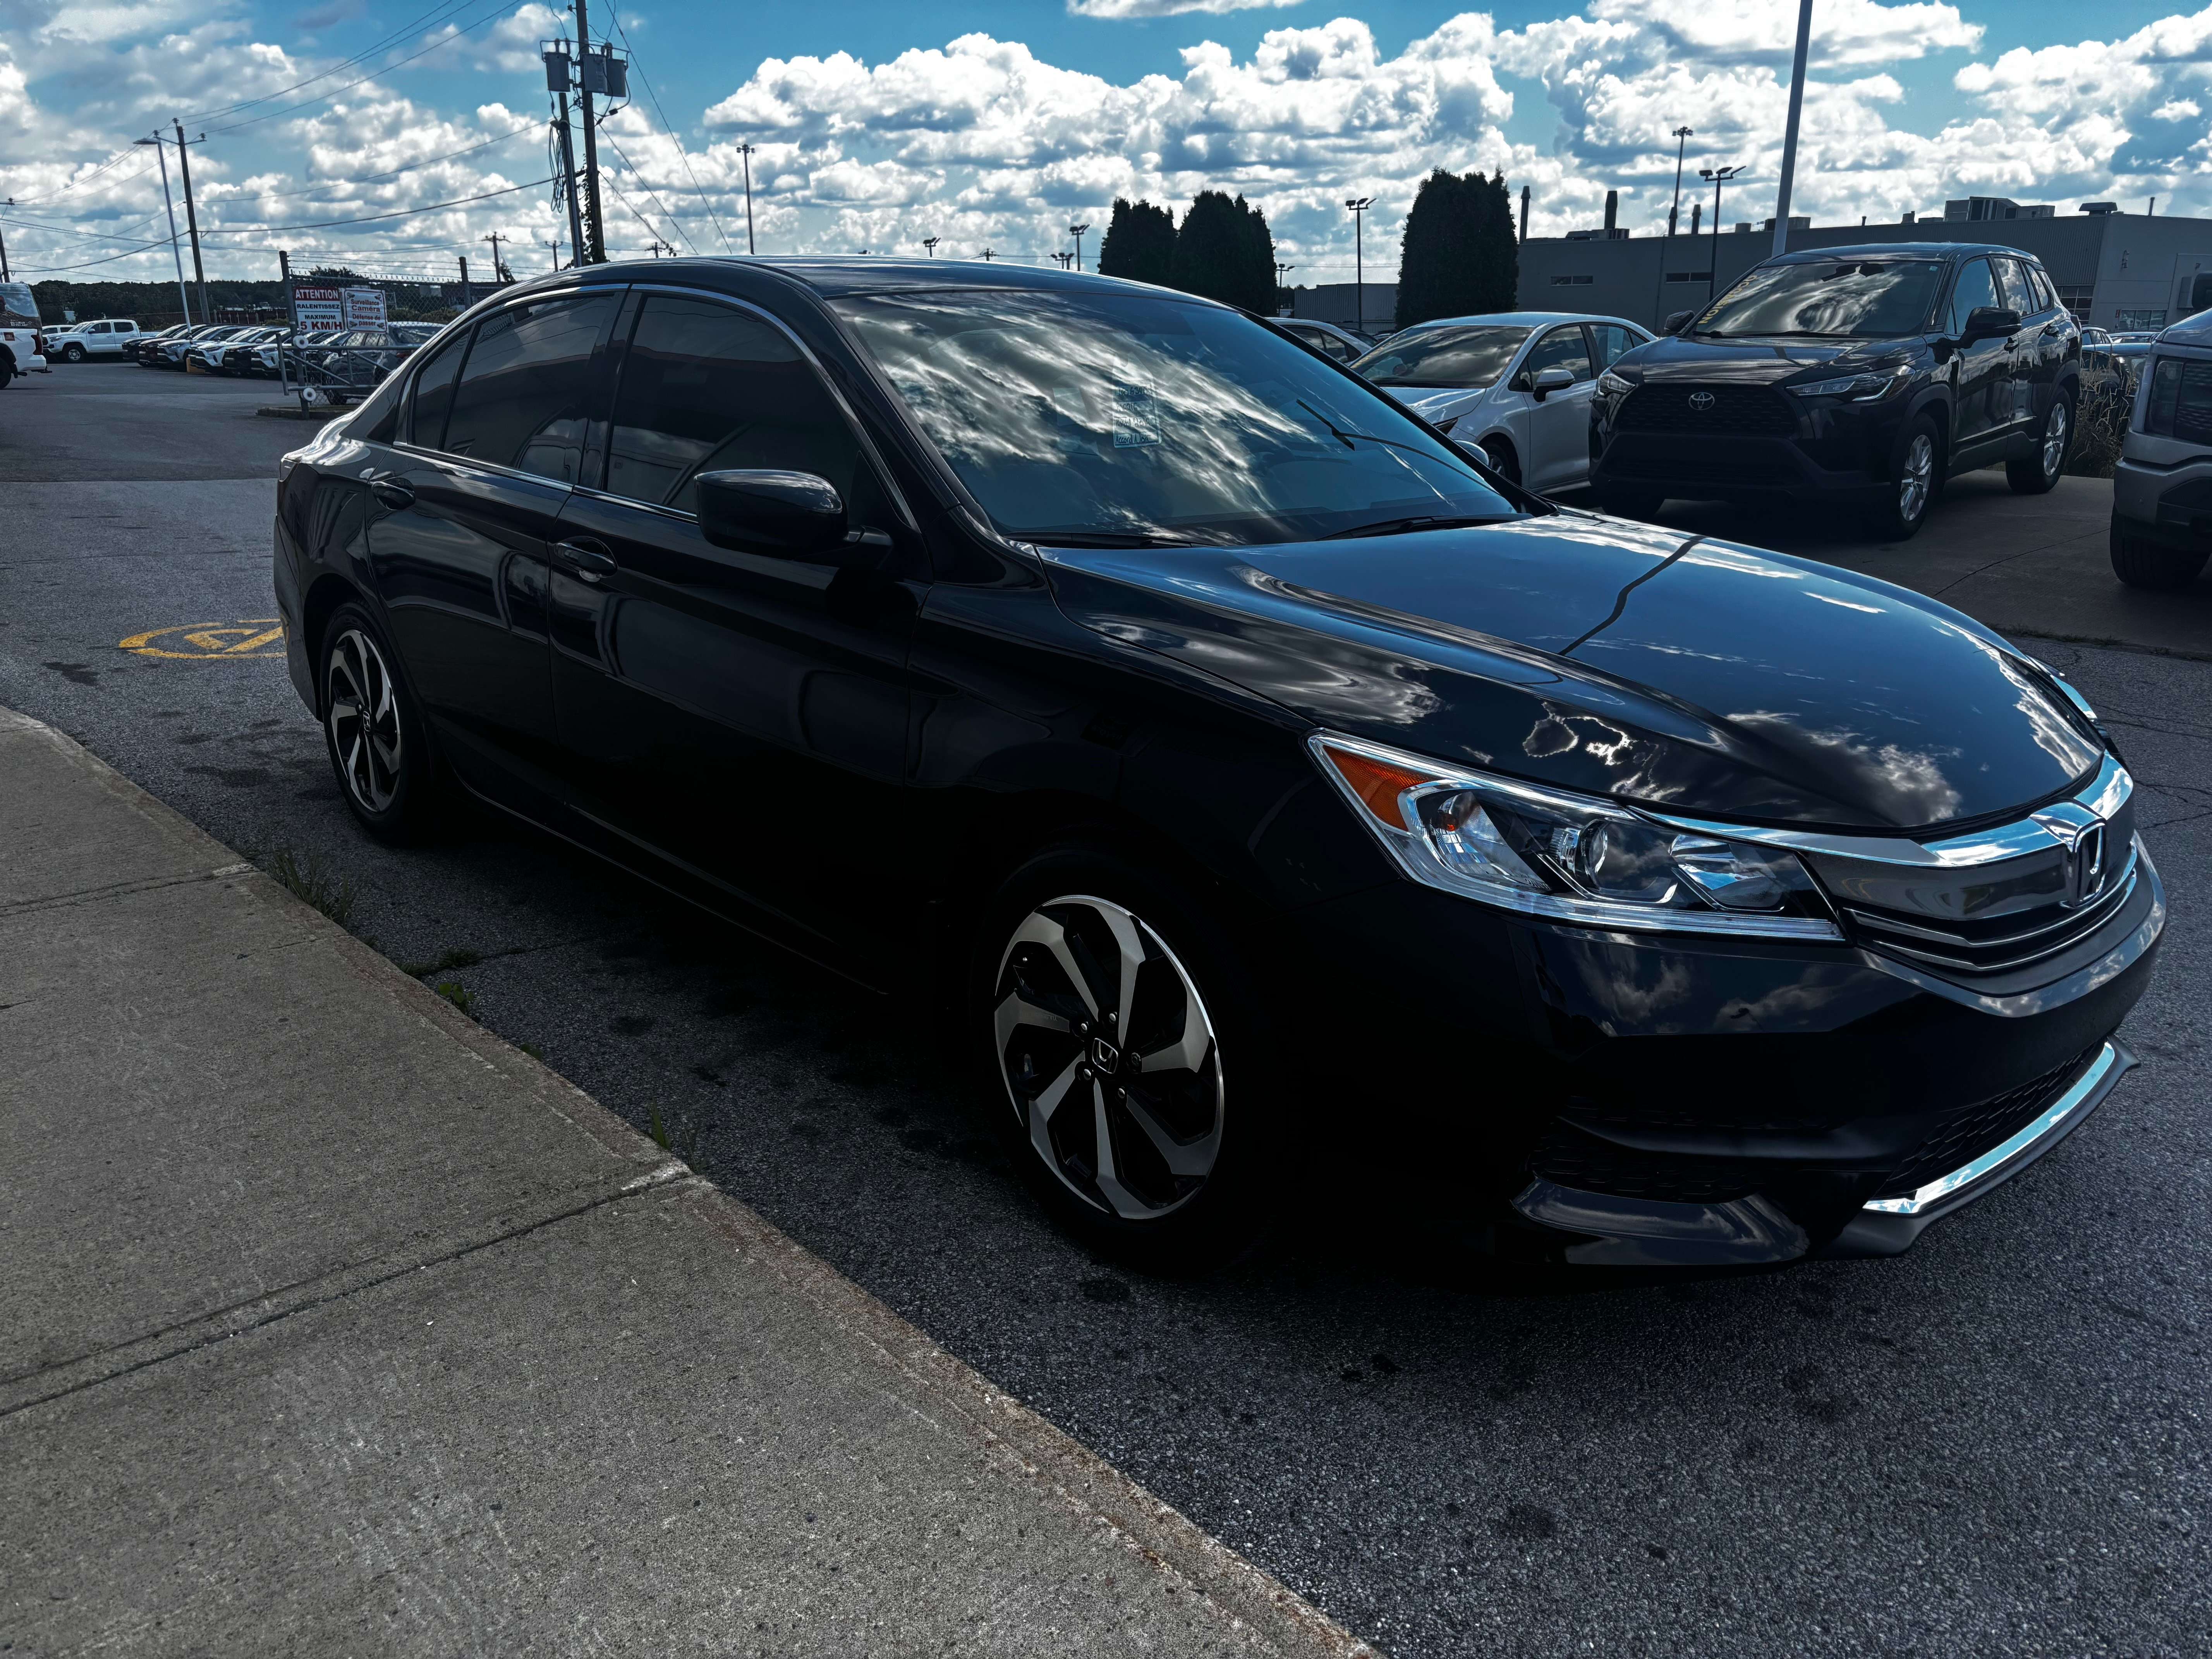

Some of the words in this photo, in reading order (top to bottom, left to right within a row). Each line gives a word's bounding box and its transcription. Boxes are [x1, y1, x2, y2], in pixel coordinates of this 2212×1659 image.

[296, 289, 339, 299] ATTENTION
[300, 321, 307, 330] 5
[311, 321, 343, 330] KM/H
